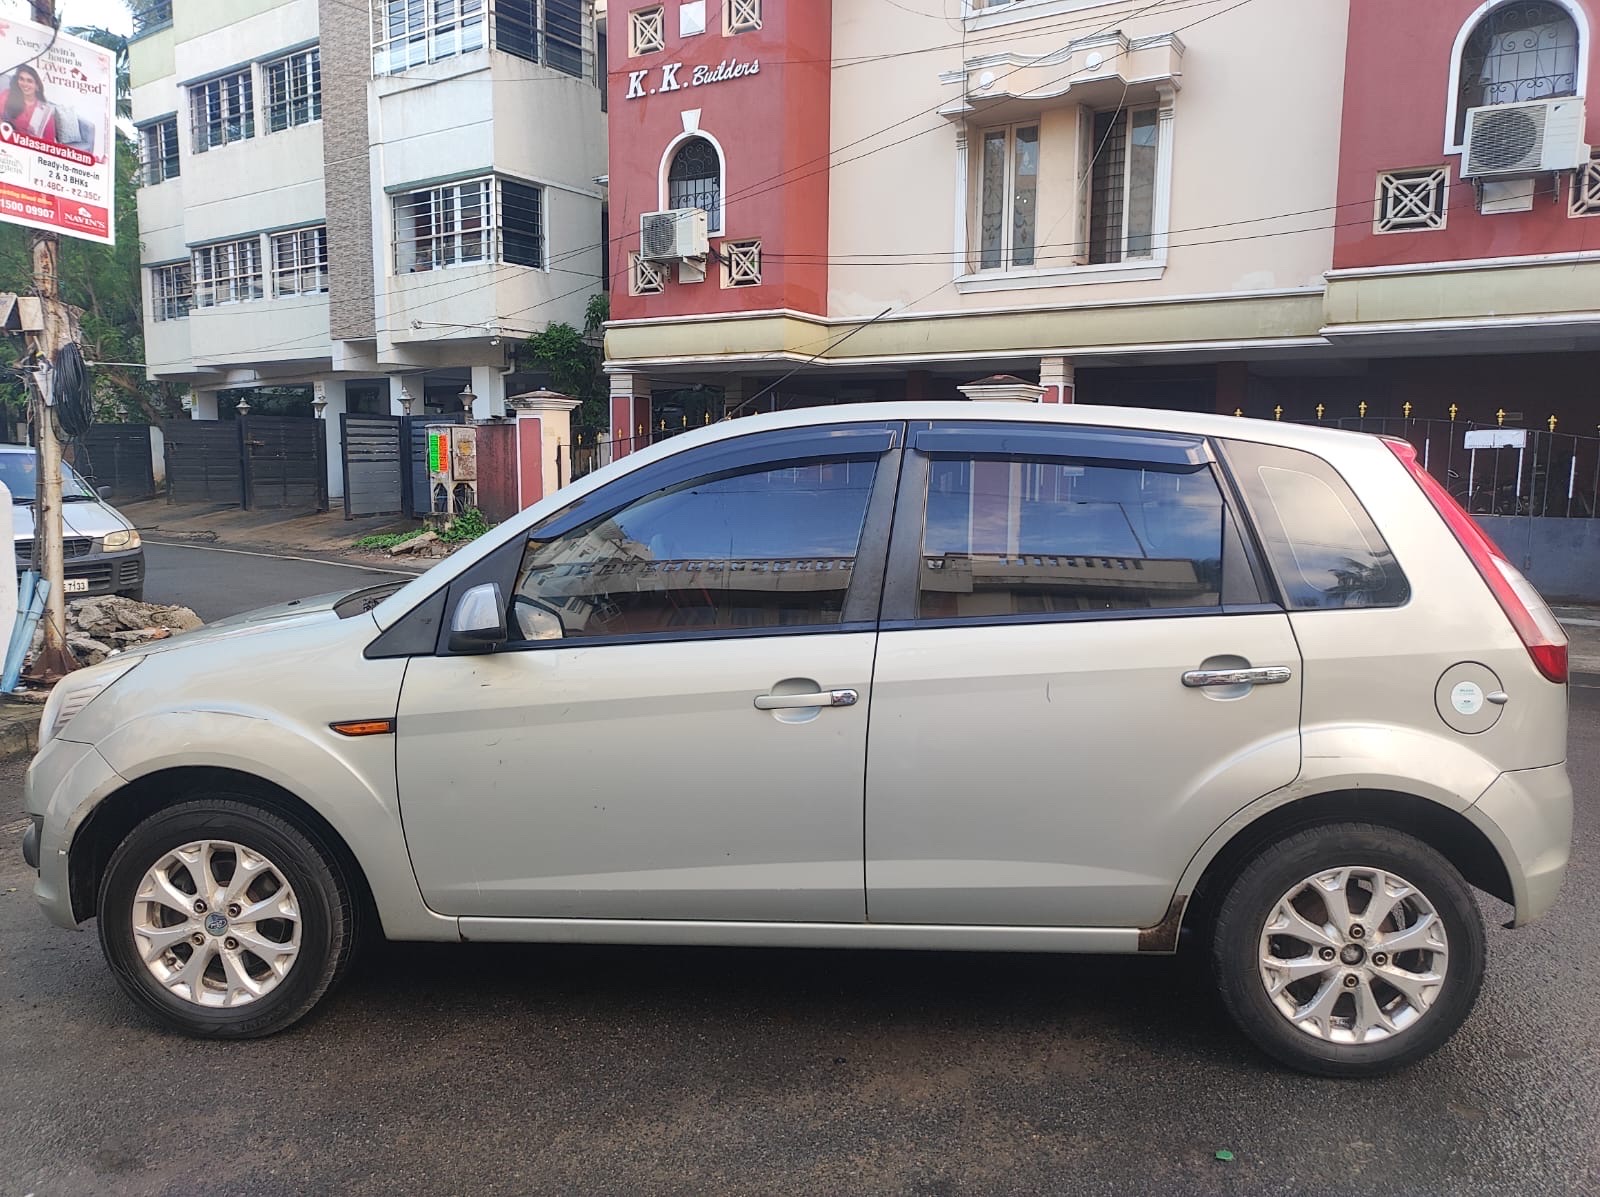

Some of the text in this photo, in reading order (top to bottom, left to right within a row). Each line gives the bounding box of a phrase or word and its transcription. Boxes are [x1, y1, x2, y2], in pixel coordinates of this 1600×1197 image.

[16, 36, 40, 52] Every
[48, 52, 73, 65] home
[692, 58, 760, 86] Builders
[43, 71, 102, 94] Arranged
[12, 132, 92, 165] Valasaravakkam
[37, 156, 100, 180] Ready-to-move-in
[48, 170, 89, 188] 2 & 3 BHKs
[25, 204, 55, 219] 09907
[64, 212, 106, 229] NAVIN'S
[68, 580, 85, 591] 7133
